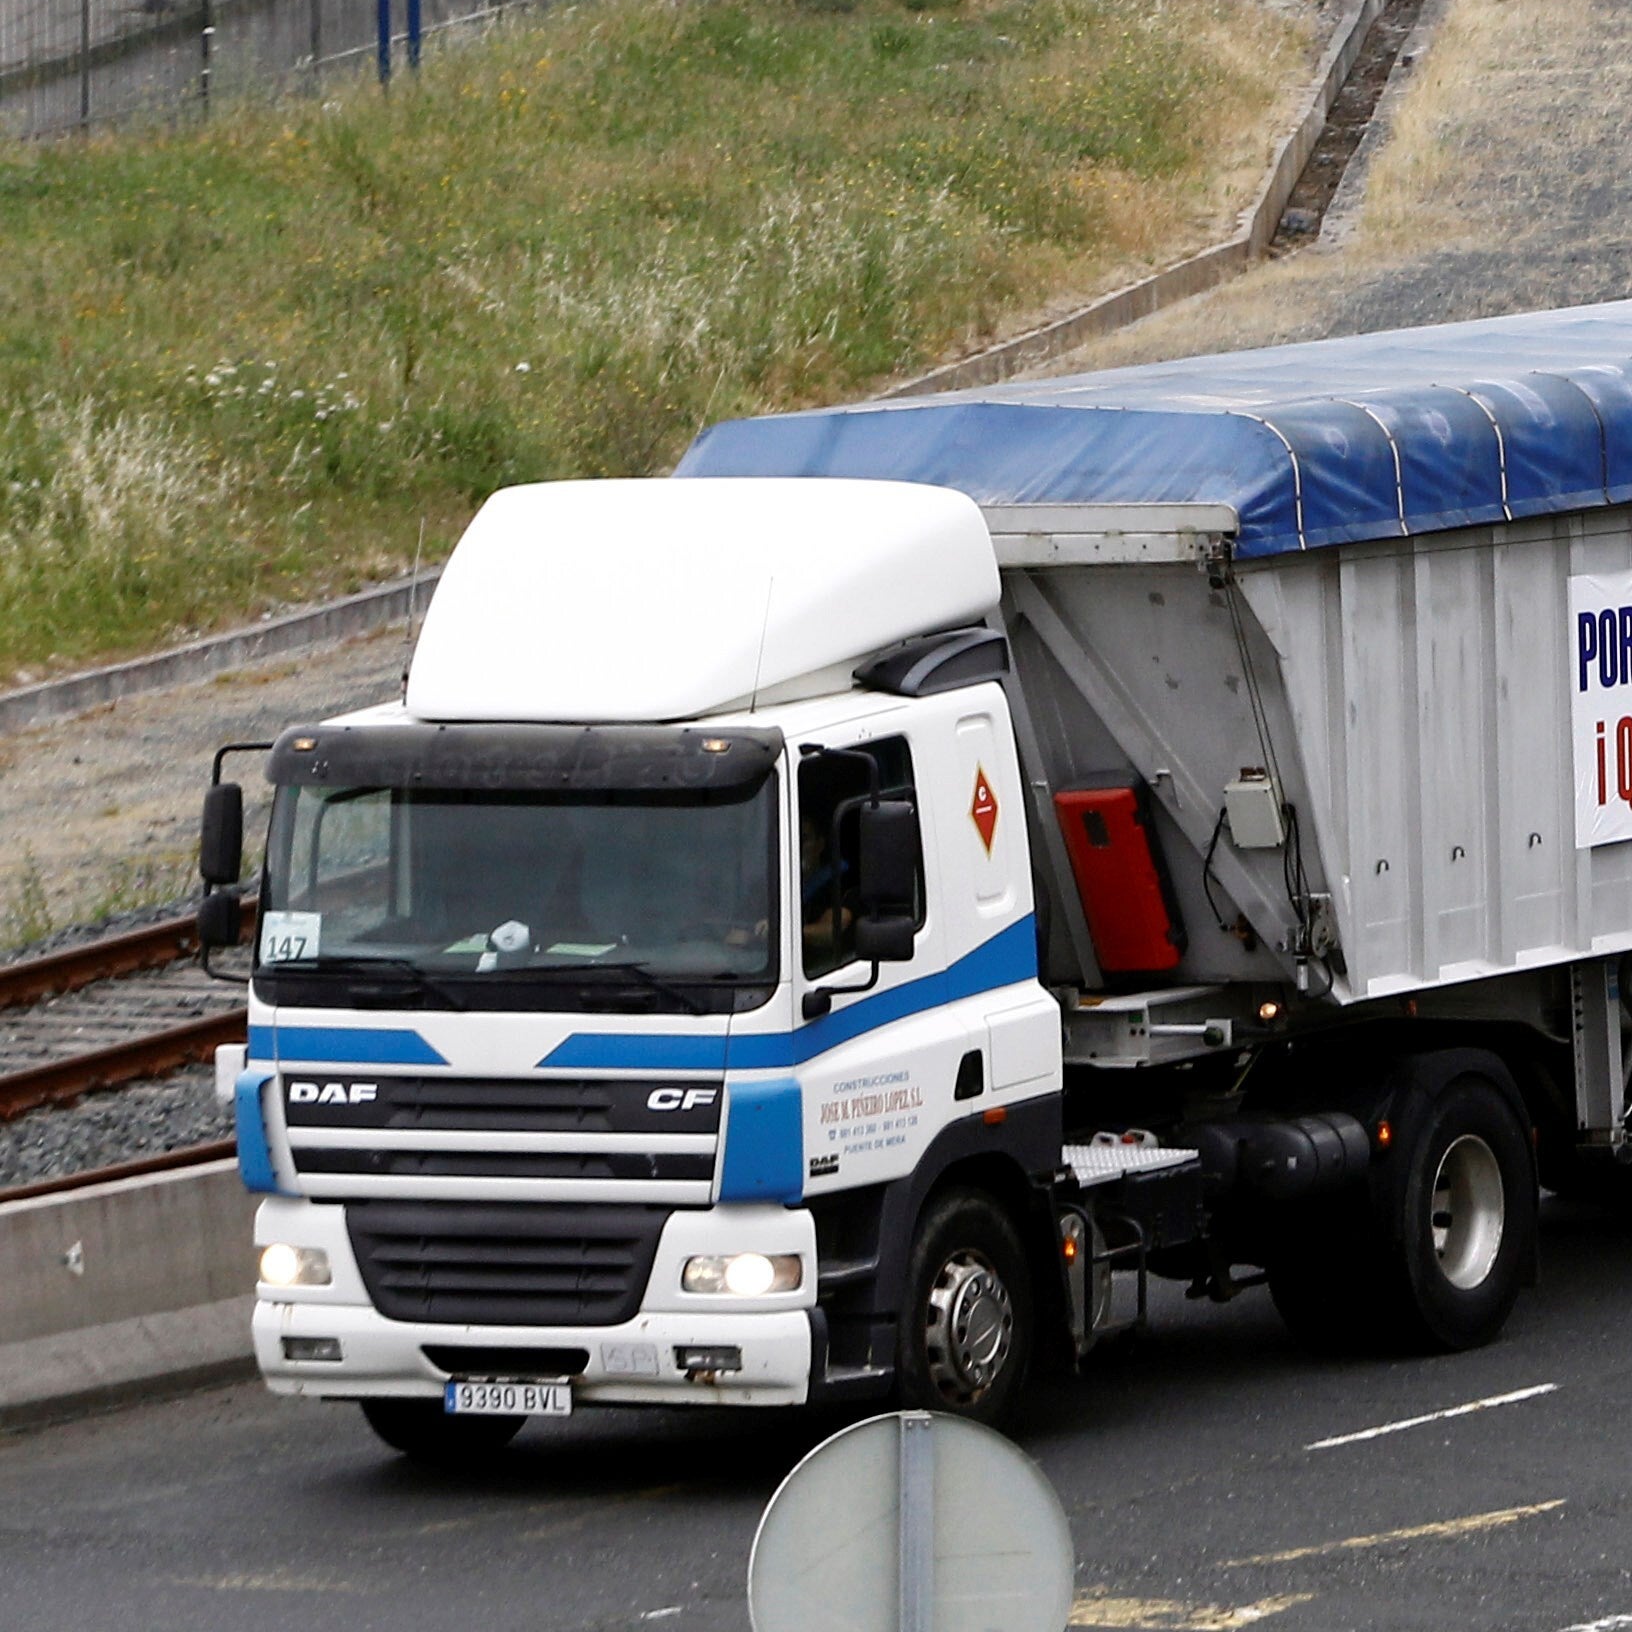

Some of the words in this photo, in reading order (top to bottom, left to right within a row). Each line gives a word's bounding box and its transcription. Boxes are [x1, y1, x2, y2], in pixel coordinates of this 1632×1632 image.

[266, 935, 308, 961] 147
[288, 1081, 378, 1104] DAF
[833, 1070, 910, 1093] CONSTRUCCIONES
[646, 1088, 718, 1110] CF
[809, 1153, 839, 1168] DAF
[460, 1385, 516, 1410] 9390
[523, 1386, 565, 1411] BVL
